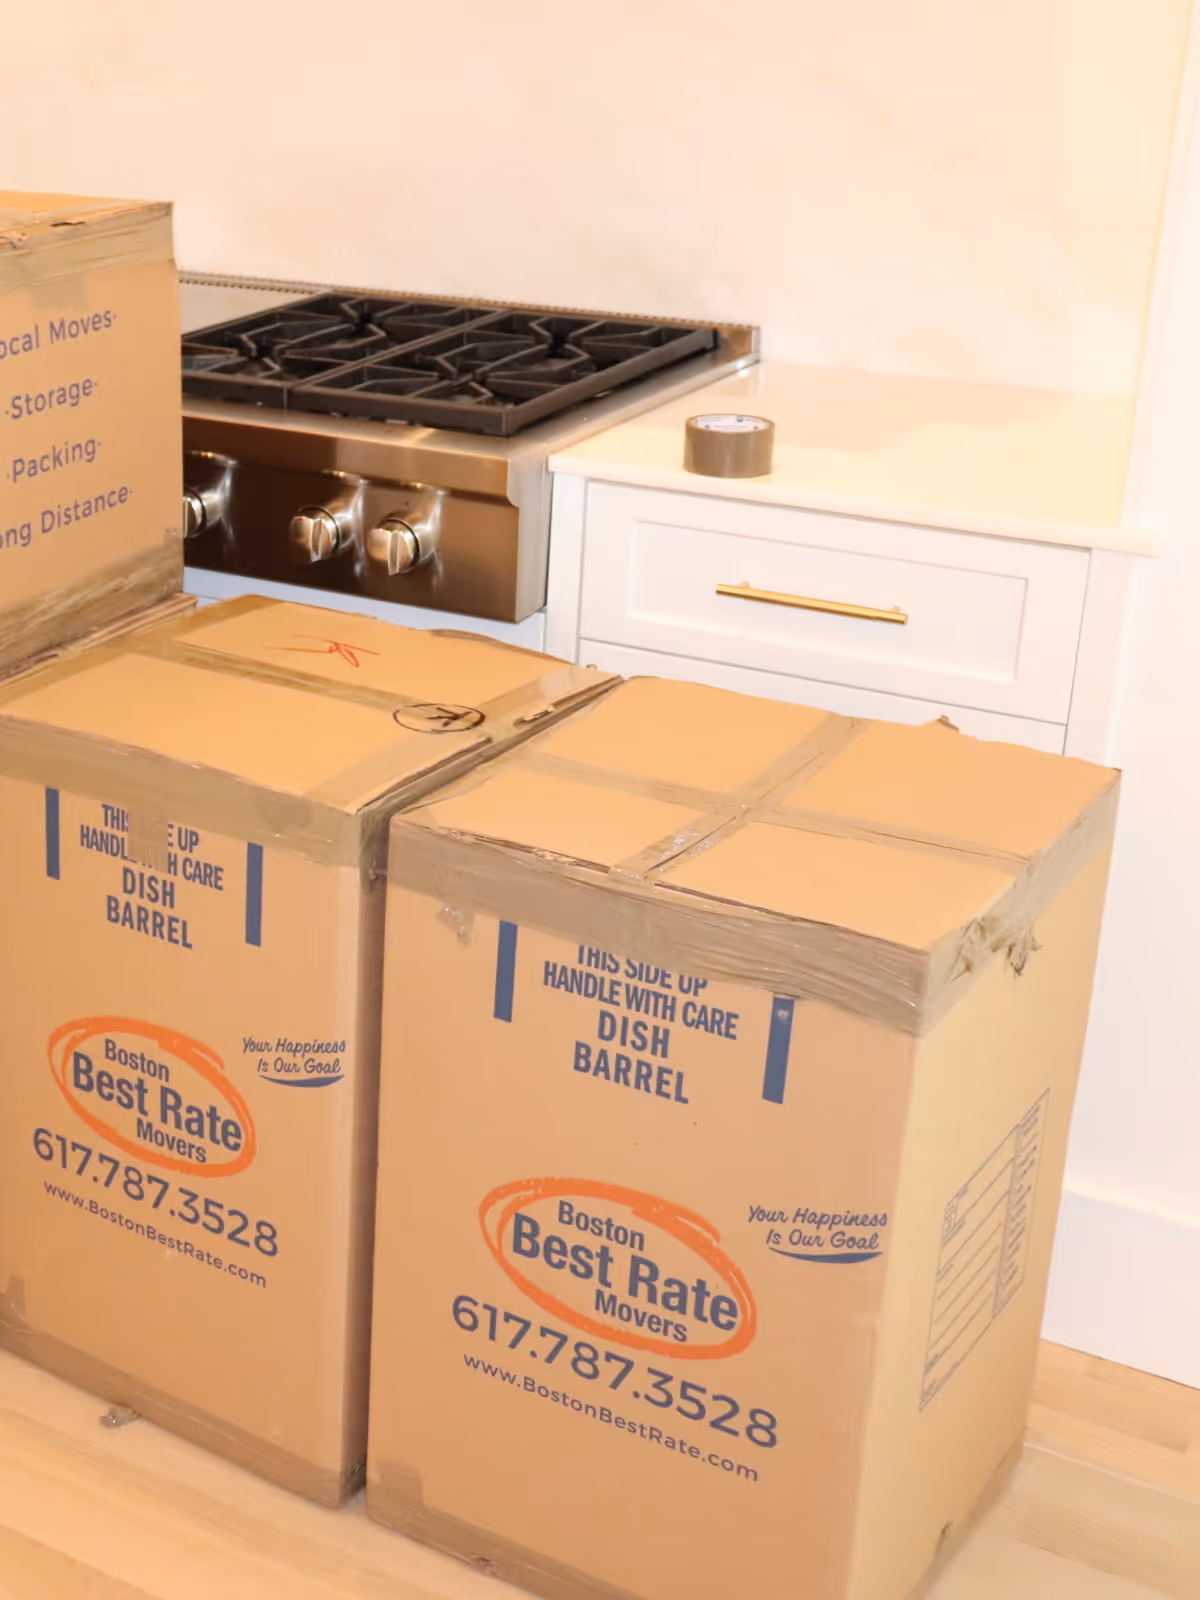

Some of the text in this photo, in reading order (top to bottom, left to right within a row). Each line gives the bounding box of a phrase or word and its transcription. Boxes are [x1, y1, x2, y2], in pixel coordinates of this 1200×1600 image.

[80, 824, 137, 863] HANDL
[182, 857, 224, 891] CARE
[177, 826, 200, 853] UP
[122, 866, 175, 909] DISH
[106, 895, 193, 949] BARREL
[543, 960, 739, 1041] HANDLE WITH CARE
[243, 1037, 346, 1058] Your Happiness
[598, 1009, 670, 1058] DISH
[105, 1038, 170, 1083] Boston
[257, 1057, 341, 1073] Is Our Goal
[573, 1040, 689, 1104] BARREL
[73, 1051, 242, 1151] Best Rate
[137, 1117, 207, 1163] Movers
[33, 1127, 279, 1257] 617.787.3528
[748, 1205, 887, 1230] Your Happiness
[44, 1180, 267, 1288] www.BostonBestRate.com
[558, 1199, 645, 1251] Boston
[766, 1229, 879, 1249] Is Our Goal
[512, 1212, 738, 1331] Best Rate
[595, 1289, 688, 1342] Movers
[452, 1294, 778, 1449] 617.787.3528
[464, 1353, 758, 1482] www.BostonBestRate.com
